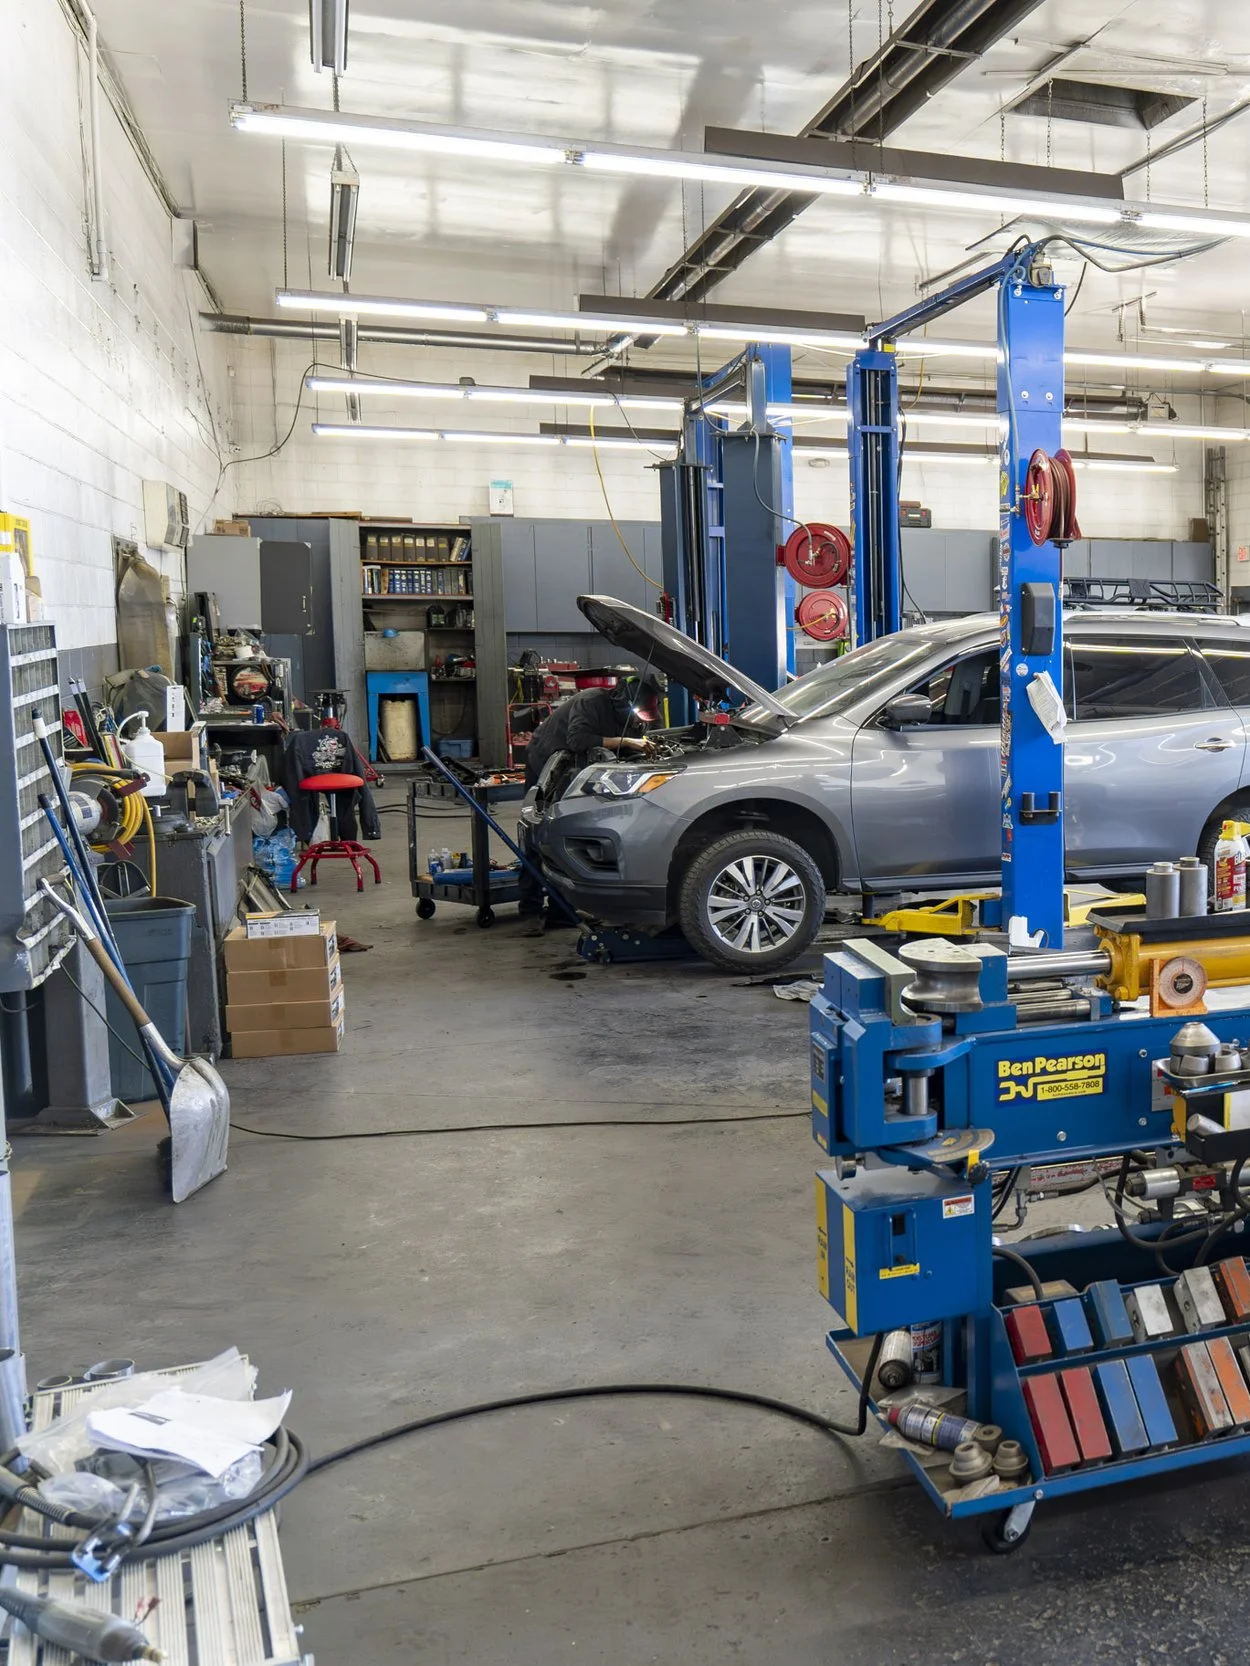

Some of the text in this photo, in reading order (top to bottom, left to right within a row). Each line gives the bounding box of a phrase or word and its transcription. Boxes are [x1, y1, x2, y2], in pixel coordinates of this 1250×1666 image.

[998, 1053, 1106, 1078] Ben Pearson
[1041, 1080, 1100, 1094] 1-800-558-7808
